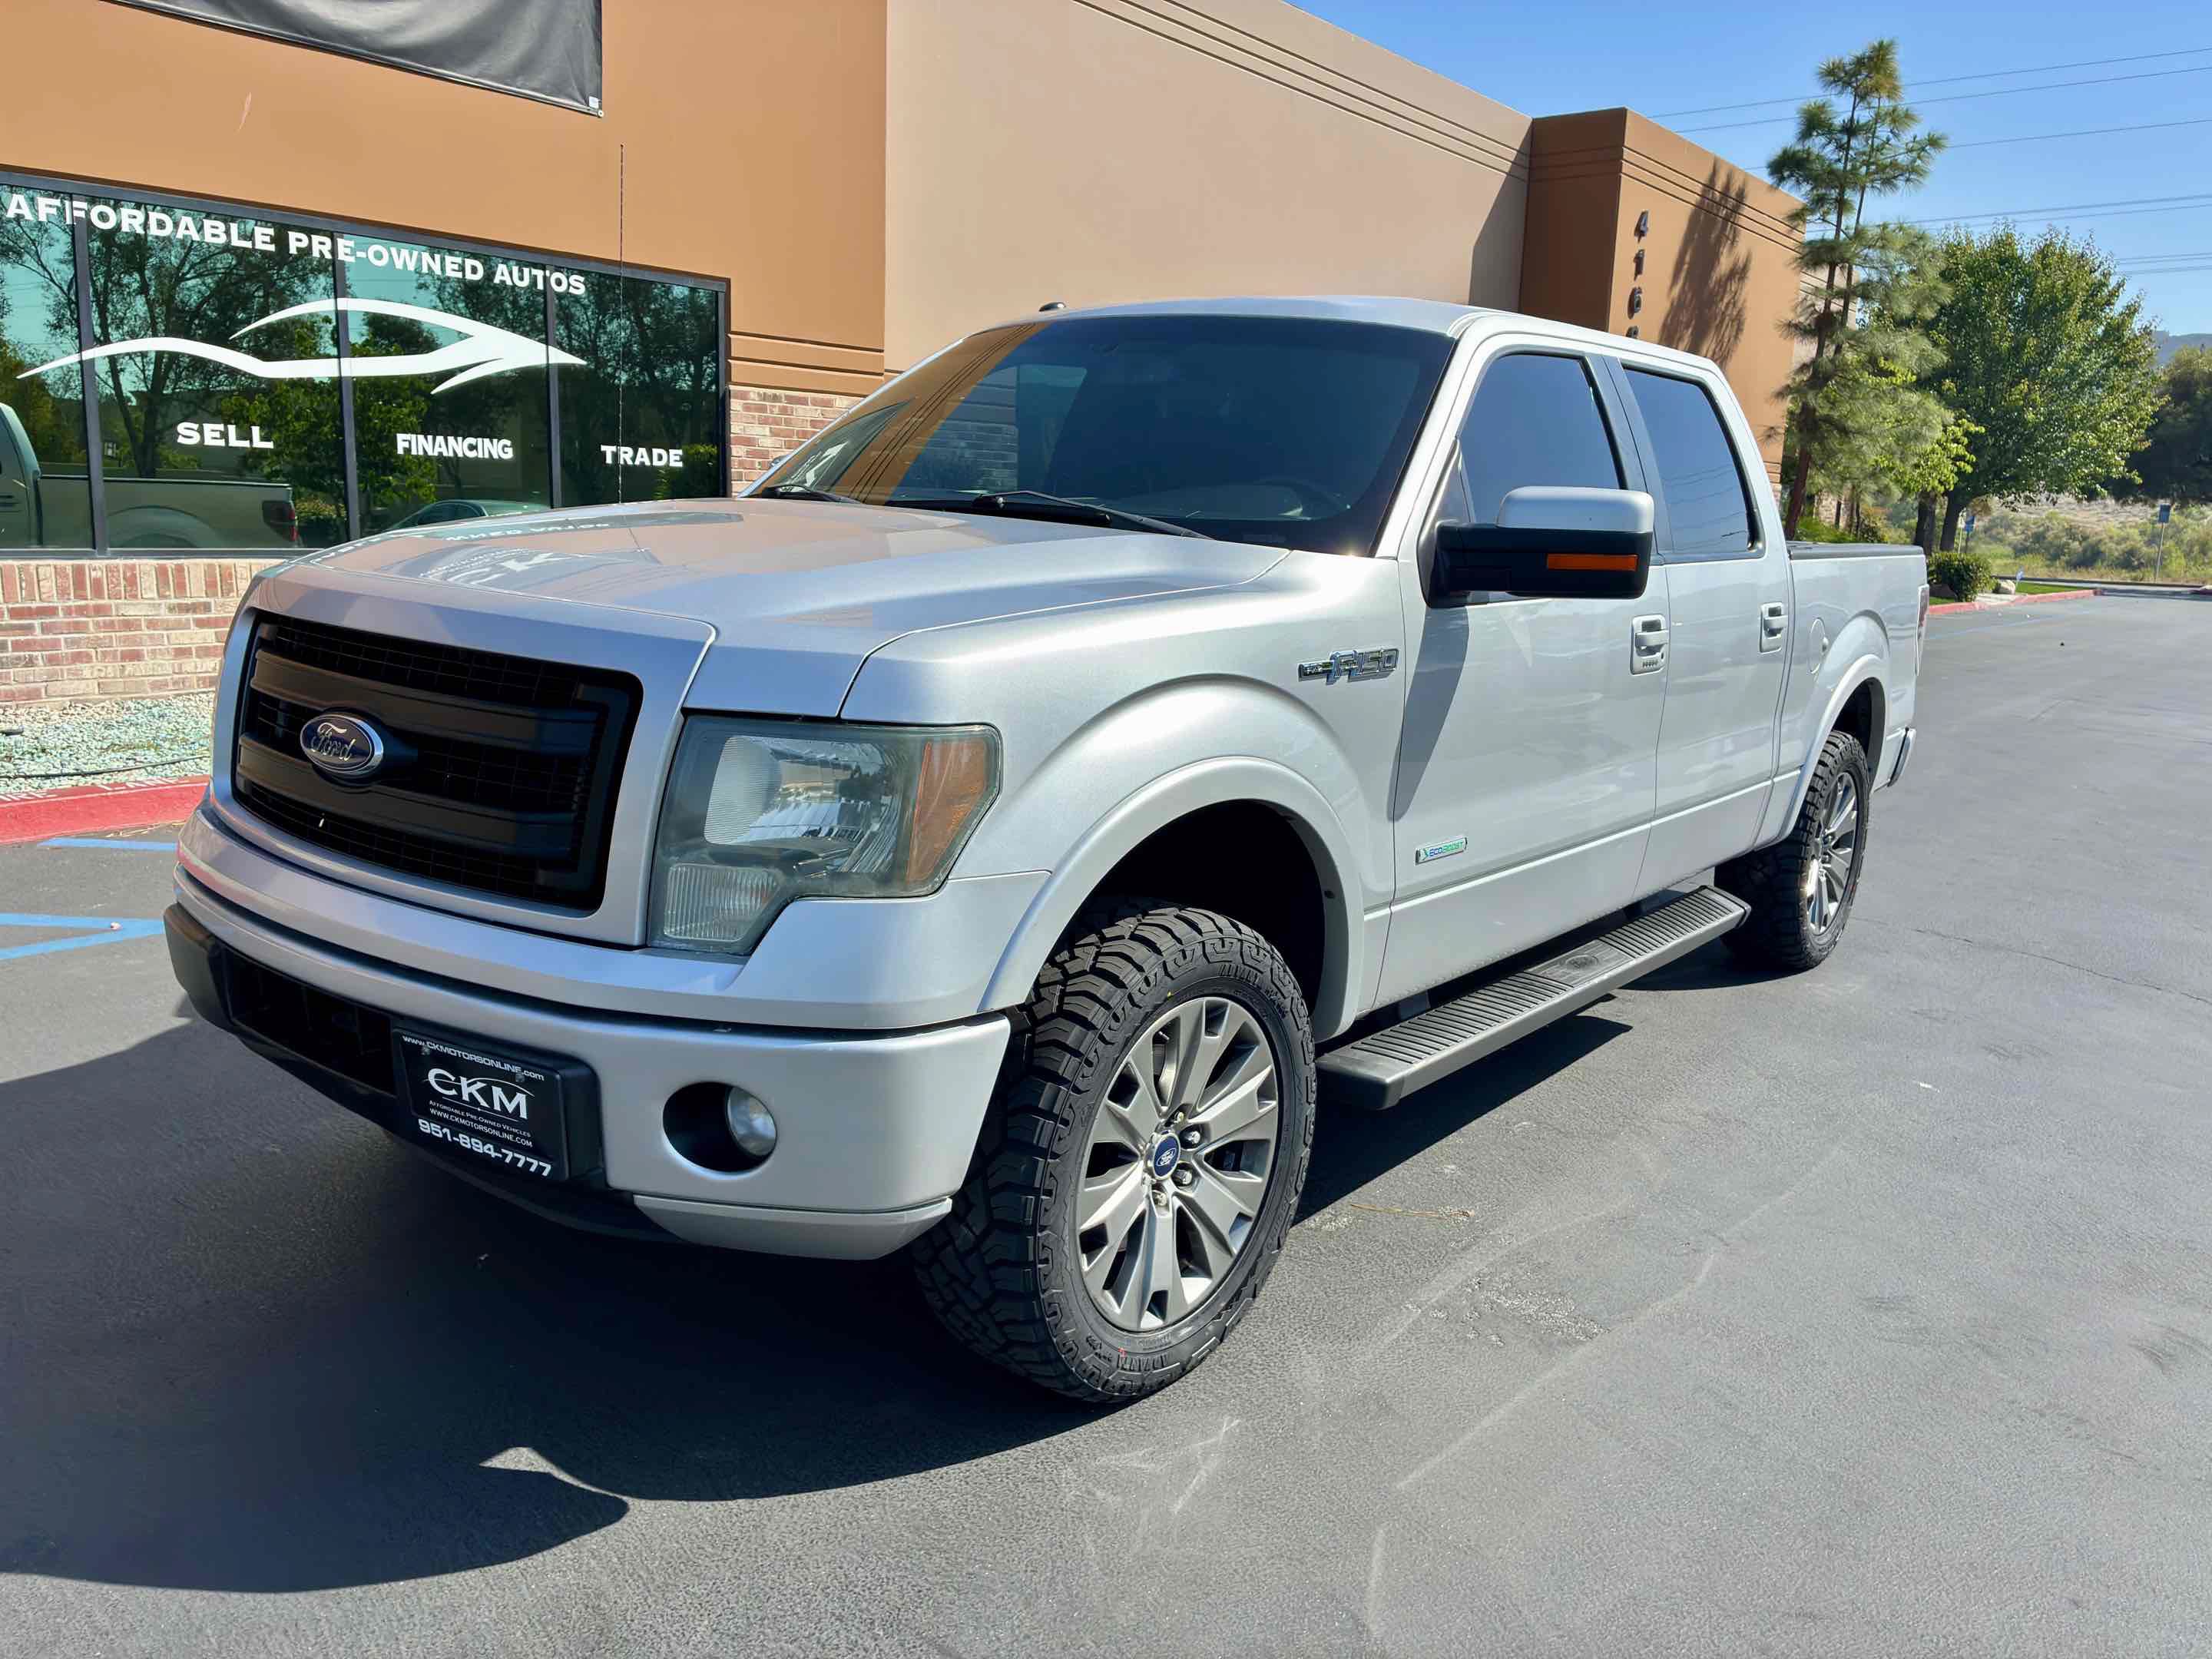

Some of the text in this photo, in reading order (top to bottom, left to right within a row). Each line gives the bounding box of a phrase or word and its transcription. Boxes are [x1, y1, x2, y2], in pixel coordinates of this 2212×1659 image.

[6, 194, 586, 296] AFFORDABLE PRE-OWNED AUTOS
[176, 421, 275, 449] SELL
[396, 432, 514, 460] FINANCING
[600, 444, 684, 468] TRADE
[310, 722, 356, 761] Ford
[427, 1068, 528, 1119] CKM
[418, 1118, 552, 1177] 951-894-7777
